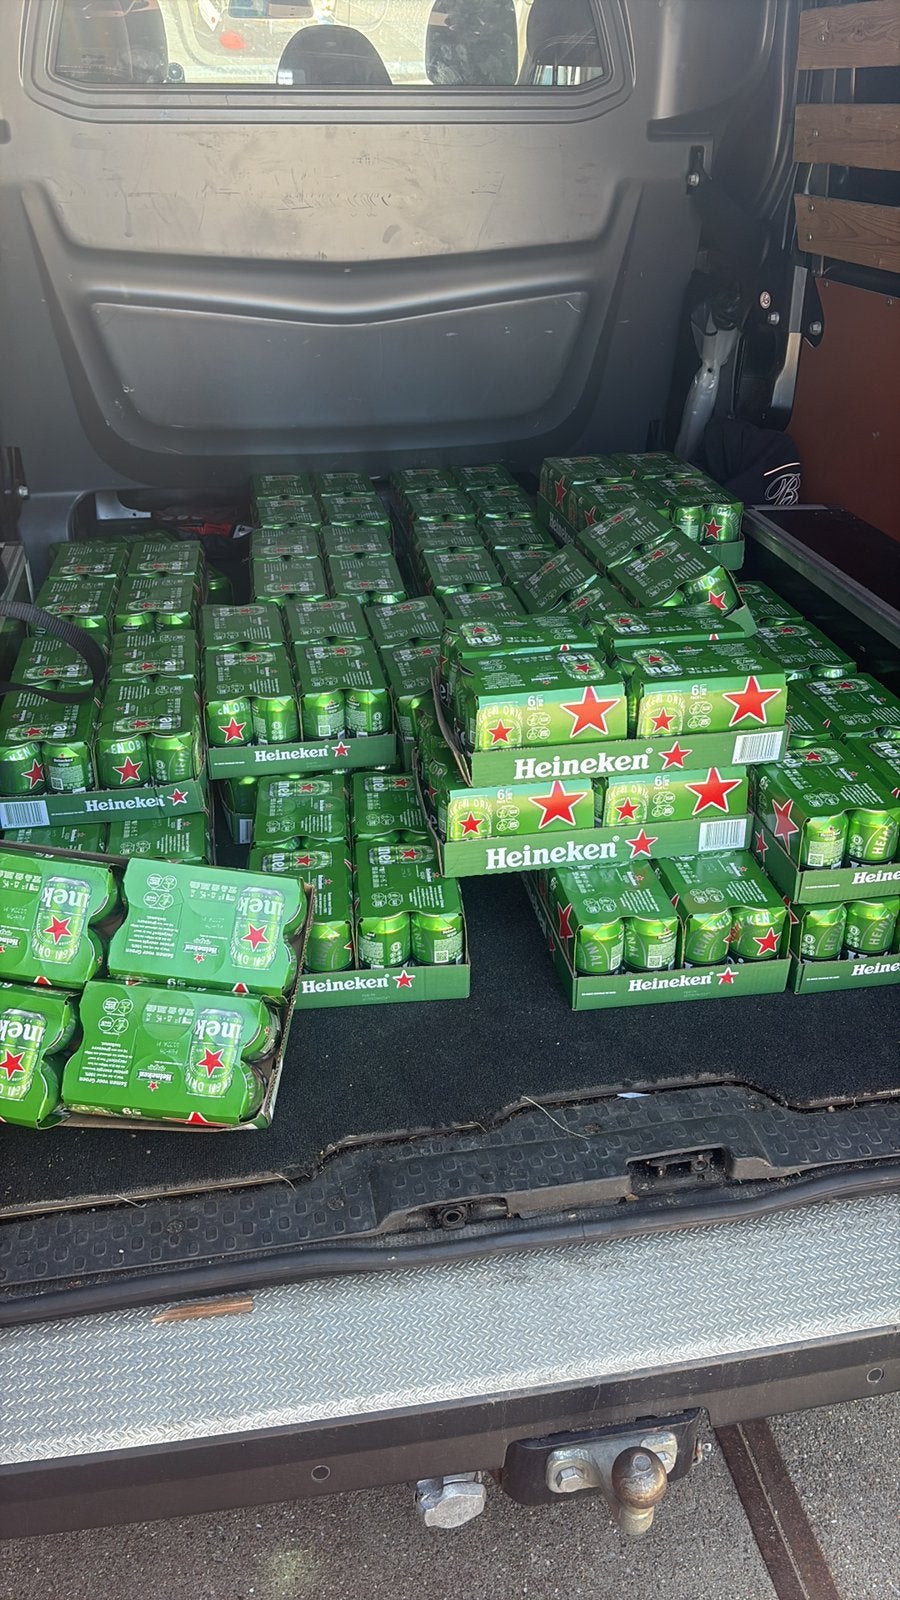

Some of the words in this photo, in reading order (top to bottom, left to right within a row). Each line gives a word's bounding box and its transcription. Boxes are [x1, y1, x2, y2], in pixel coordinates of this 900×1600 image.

[691, 684, 700, 696] 6
[527, 695, 536, 706] 6
[255, 747, 329, 763] Heineken
[514, 749, 651, 780] Heineken
[497, 789, 505, 800] 6
[84, 797, 166, 813] Heineken
[486, 840, 618, 869] Heineken
[302, 976, 389, 993] Heineken
[628, 974, 713, 992] Heineken
[138, 1070, 172, 1082] Heineken
